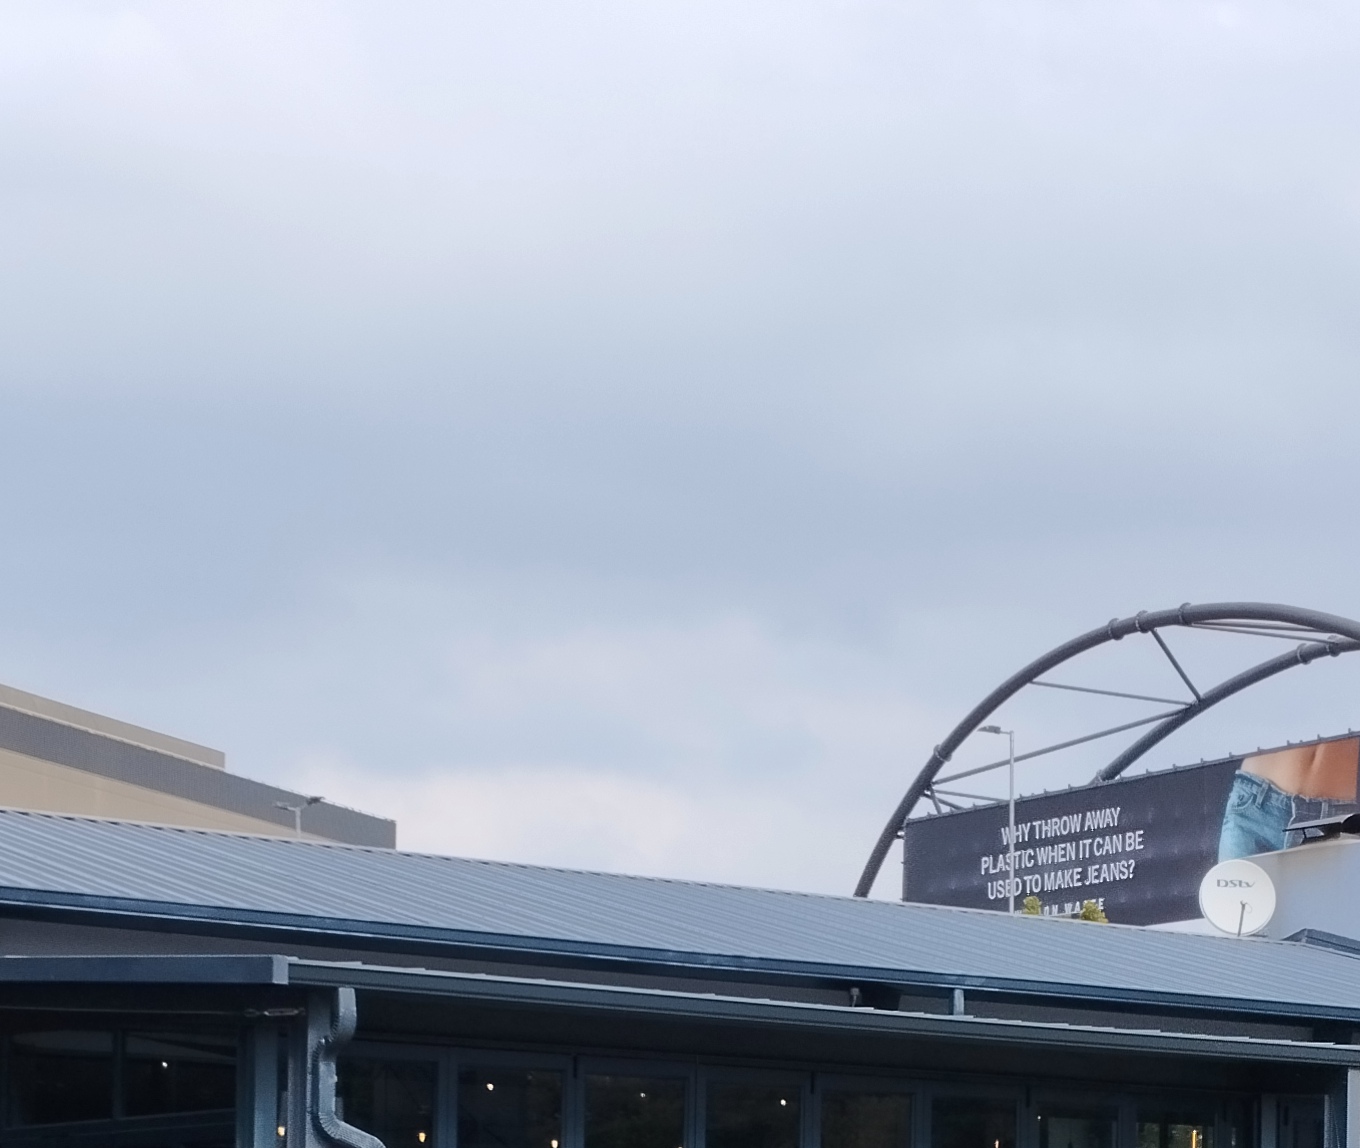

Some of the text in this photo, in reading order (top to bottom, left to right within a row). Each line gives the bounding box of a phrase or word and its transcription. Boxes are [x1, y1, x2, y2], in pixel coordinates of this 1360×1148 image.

[1001, 806, 1121, 846] WHY THROW AWAY
[980, 829, 1145, 875] PLASTIC WHEN IT CAN BE
[987, 859, 1136, 900] USED TO MAKE JEANS?
